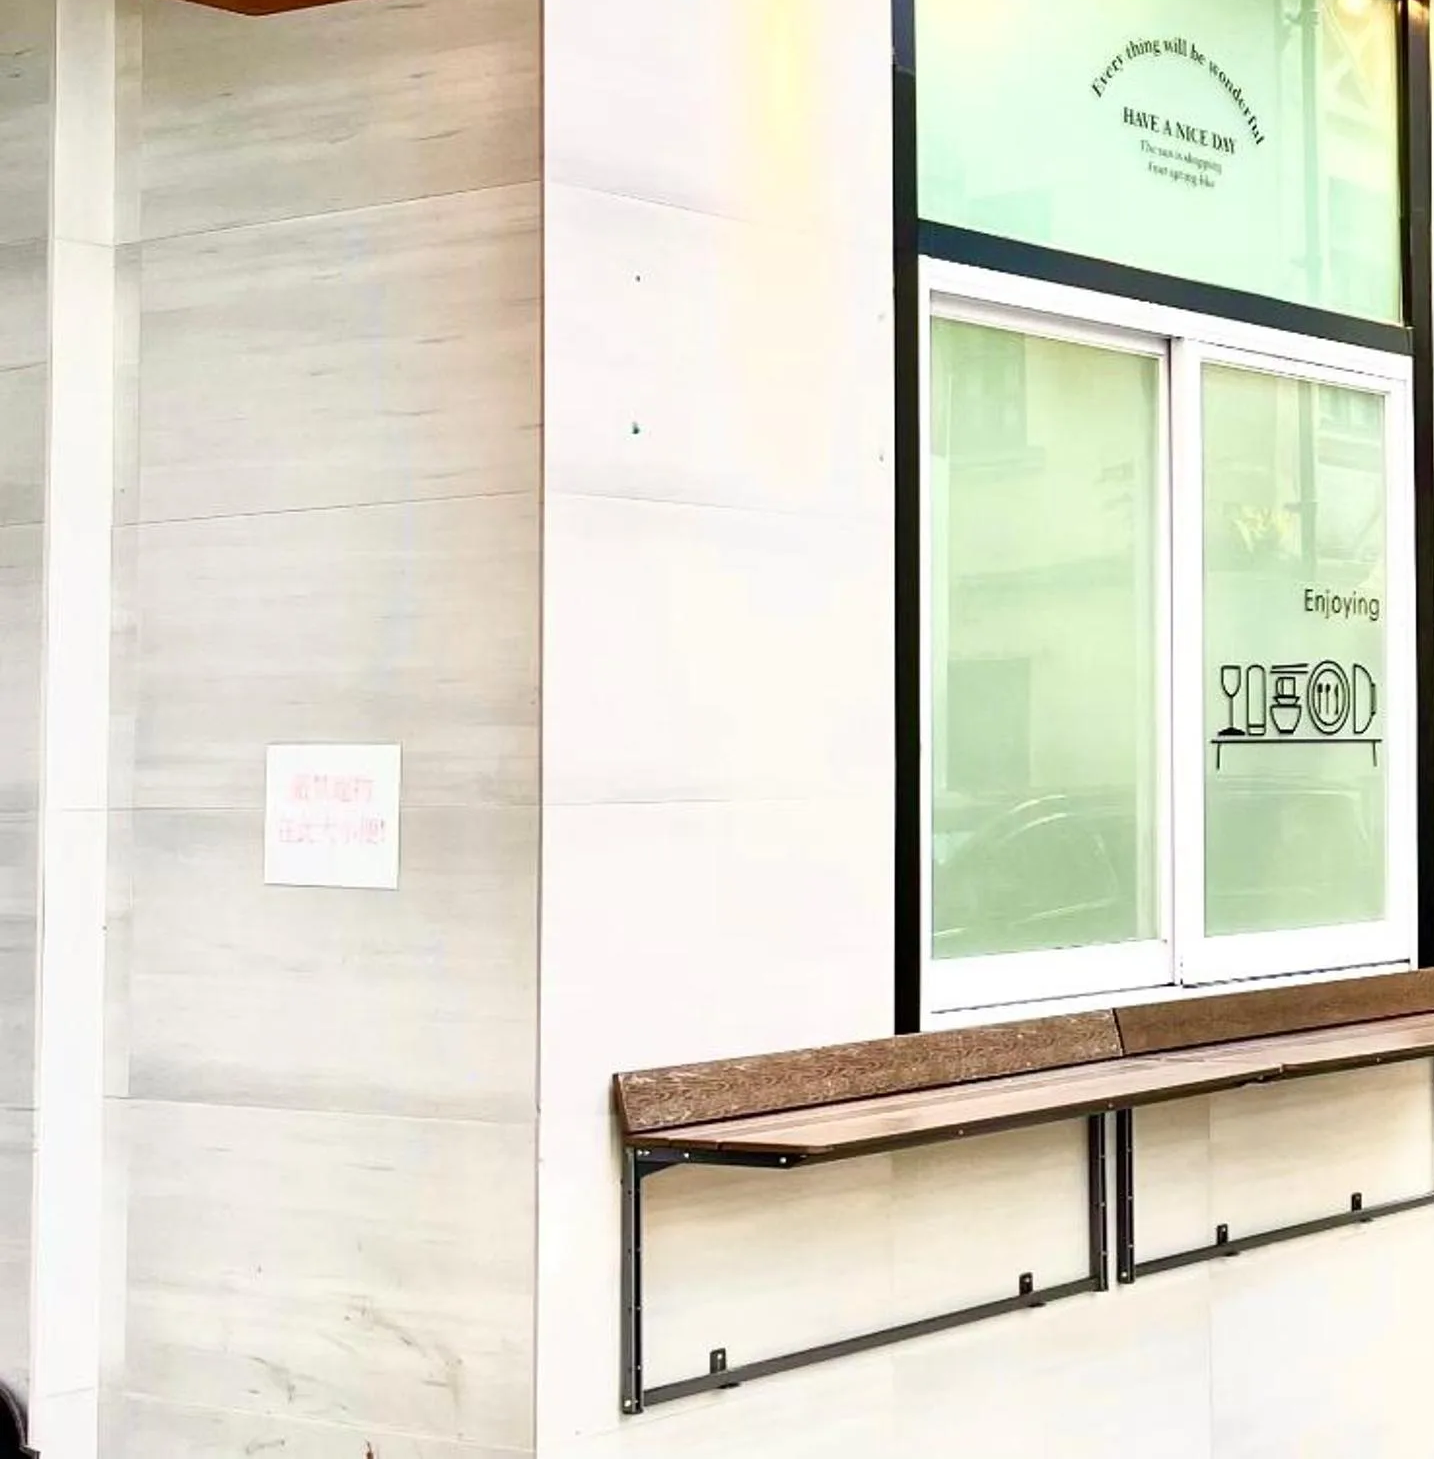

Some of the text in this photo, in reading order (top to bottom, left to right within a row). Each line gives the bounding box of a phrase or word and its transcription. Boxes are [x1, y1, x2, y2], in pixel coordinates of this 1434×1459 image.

[1163, 37, 1187, 57] will
[1190, 43, 1206, 66] be
[1208, 60, 1265, 145] wonderful
[1122, 106, 1237, 154] HAVE A NICE DAY
[1303, 588, 1380, 622] Enjoying
